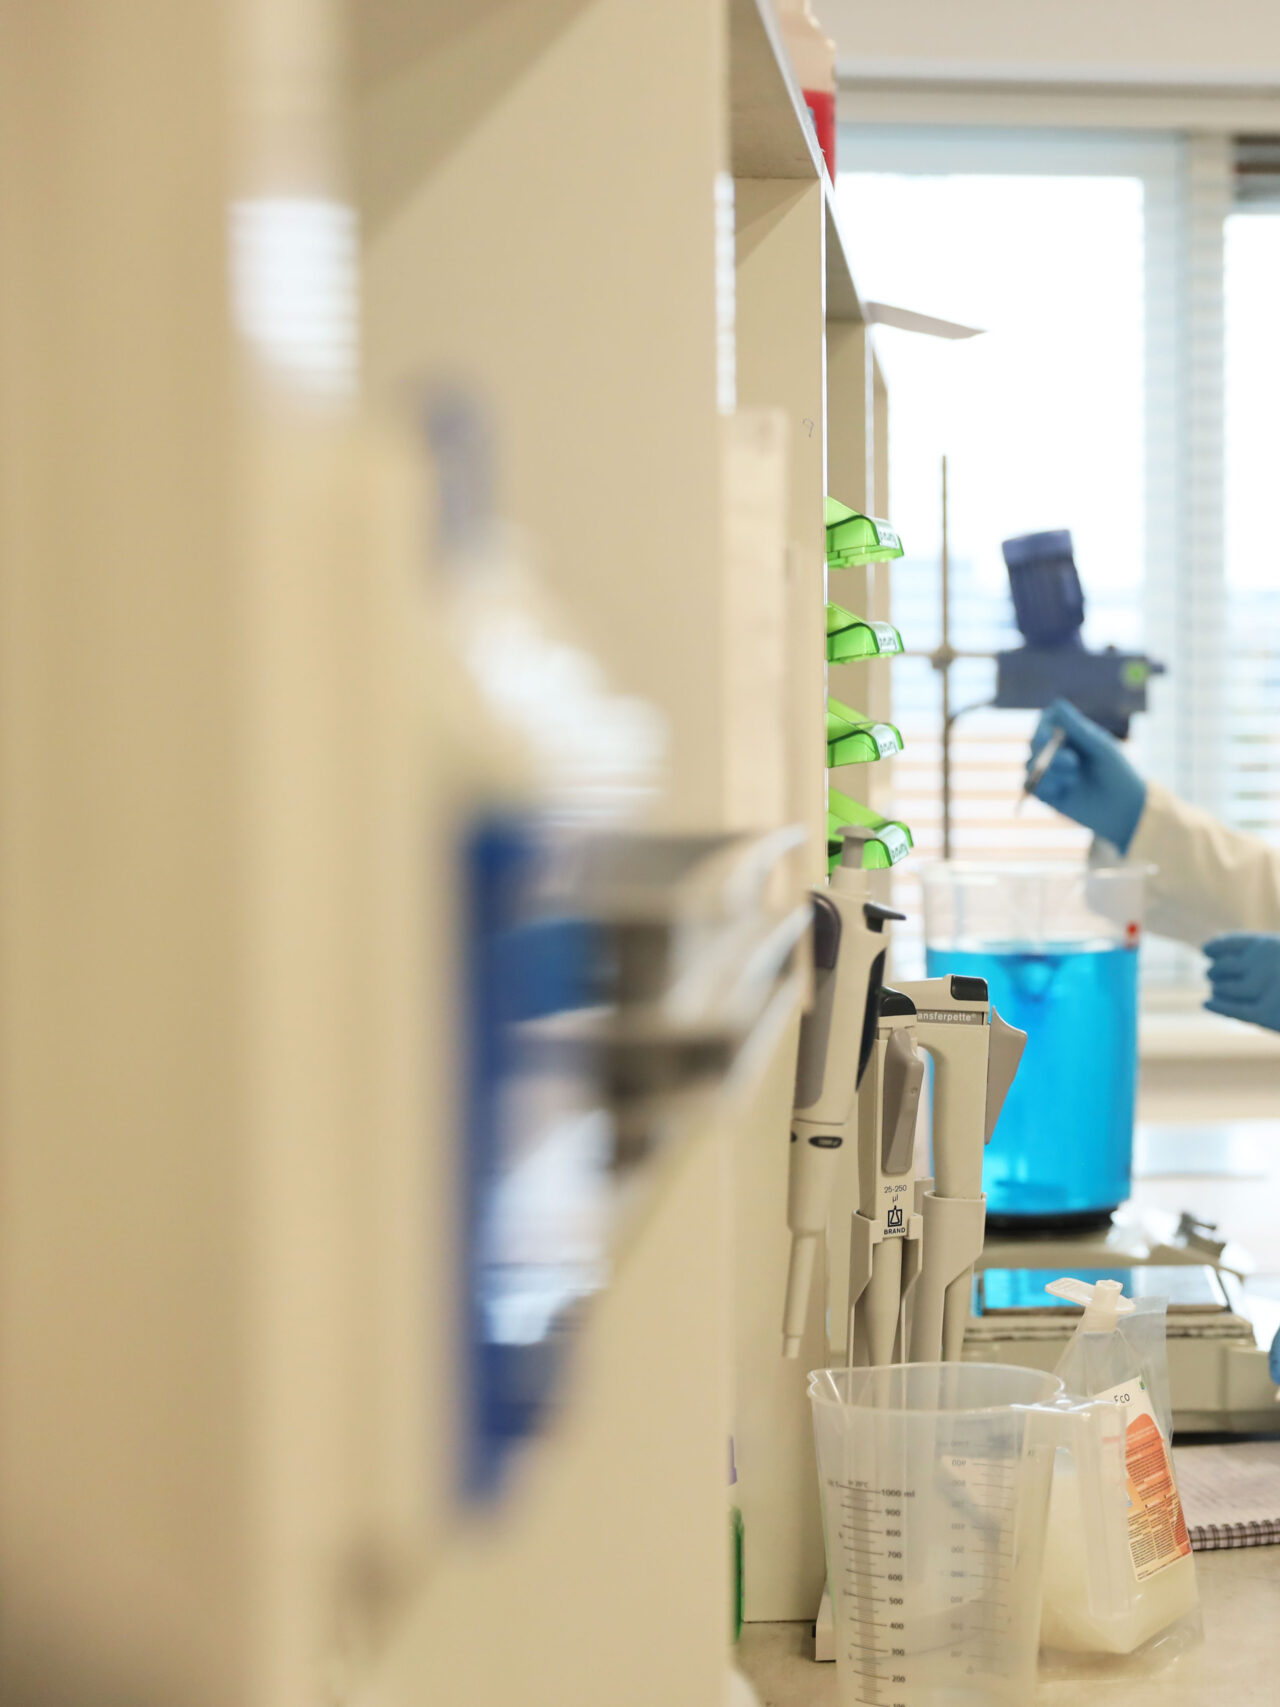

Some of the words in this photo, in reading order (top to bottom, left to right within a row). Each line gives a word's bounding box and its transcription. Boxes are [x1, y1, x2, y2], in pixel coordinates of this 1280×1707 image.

[884, 1185, 907, 1194] 25-250
[884, 1227, 906, 1235] BRAND
[881, 1489, 902, 1497] 1000
[885, 1508, 901, 1516] 900
[886, 1529, 901, 1537] 800
[887, 1551, 902, 1559] 700
[887, 1574, 902, 1582] 600
[888, 1597, 903, 1605] 500
[892, 1675, 906, 1683] 200
